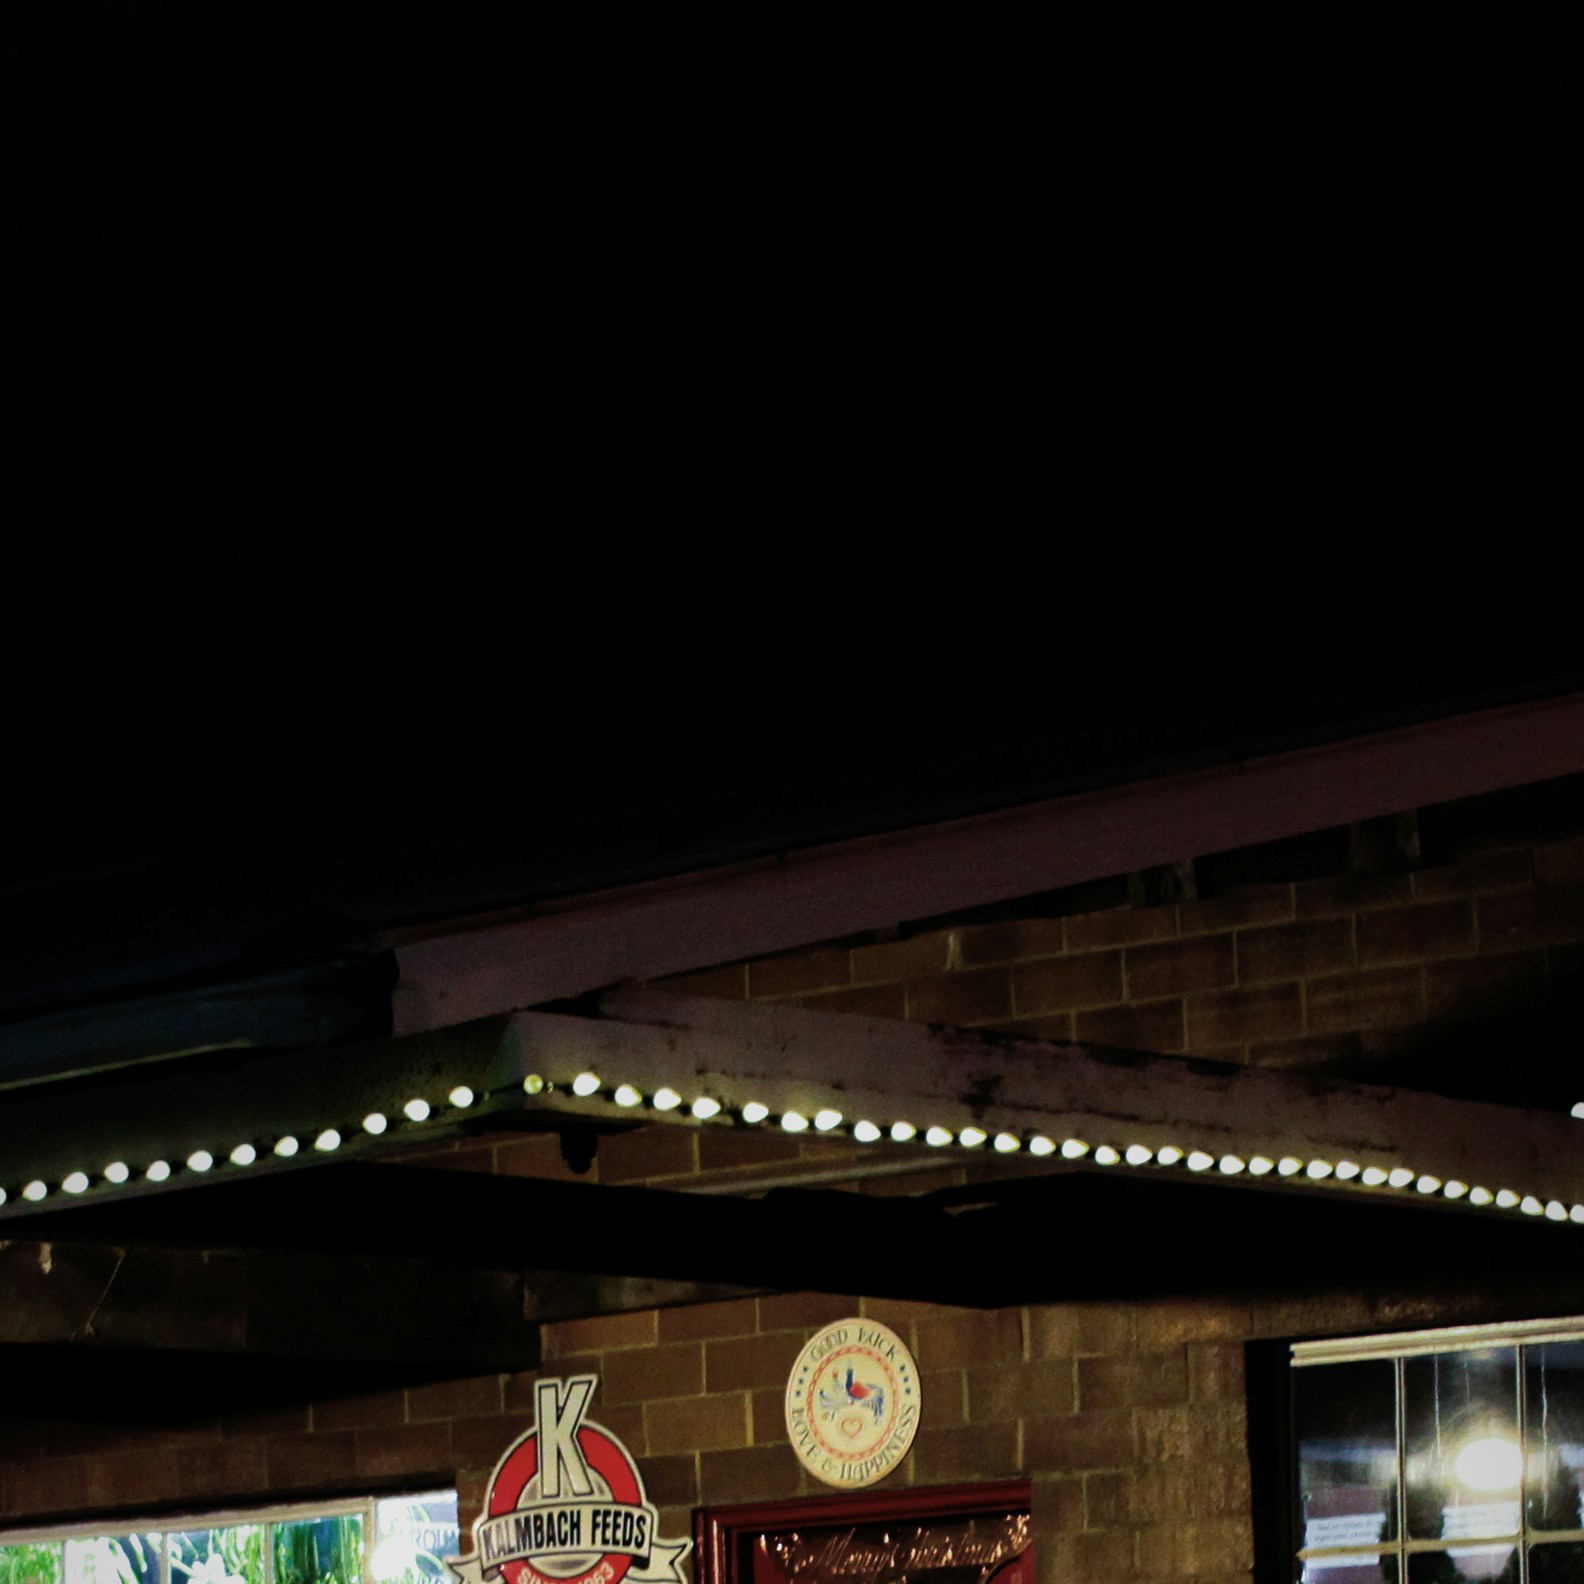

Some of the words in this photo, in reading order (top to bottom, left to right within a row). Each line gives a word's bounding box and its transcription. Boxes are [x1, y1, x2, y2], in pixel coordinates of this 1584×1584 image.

[535, 1377, 597, 1500] K
[482, 1508, 581, 1561] KALMBACH
[592, 1509, 647, 1549] FEEDS
